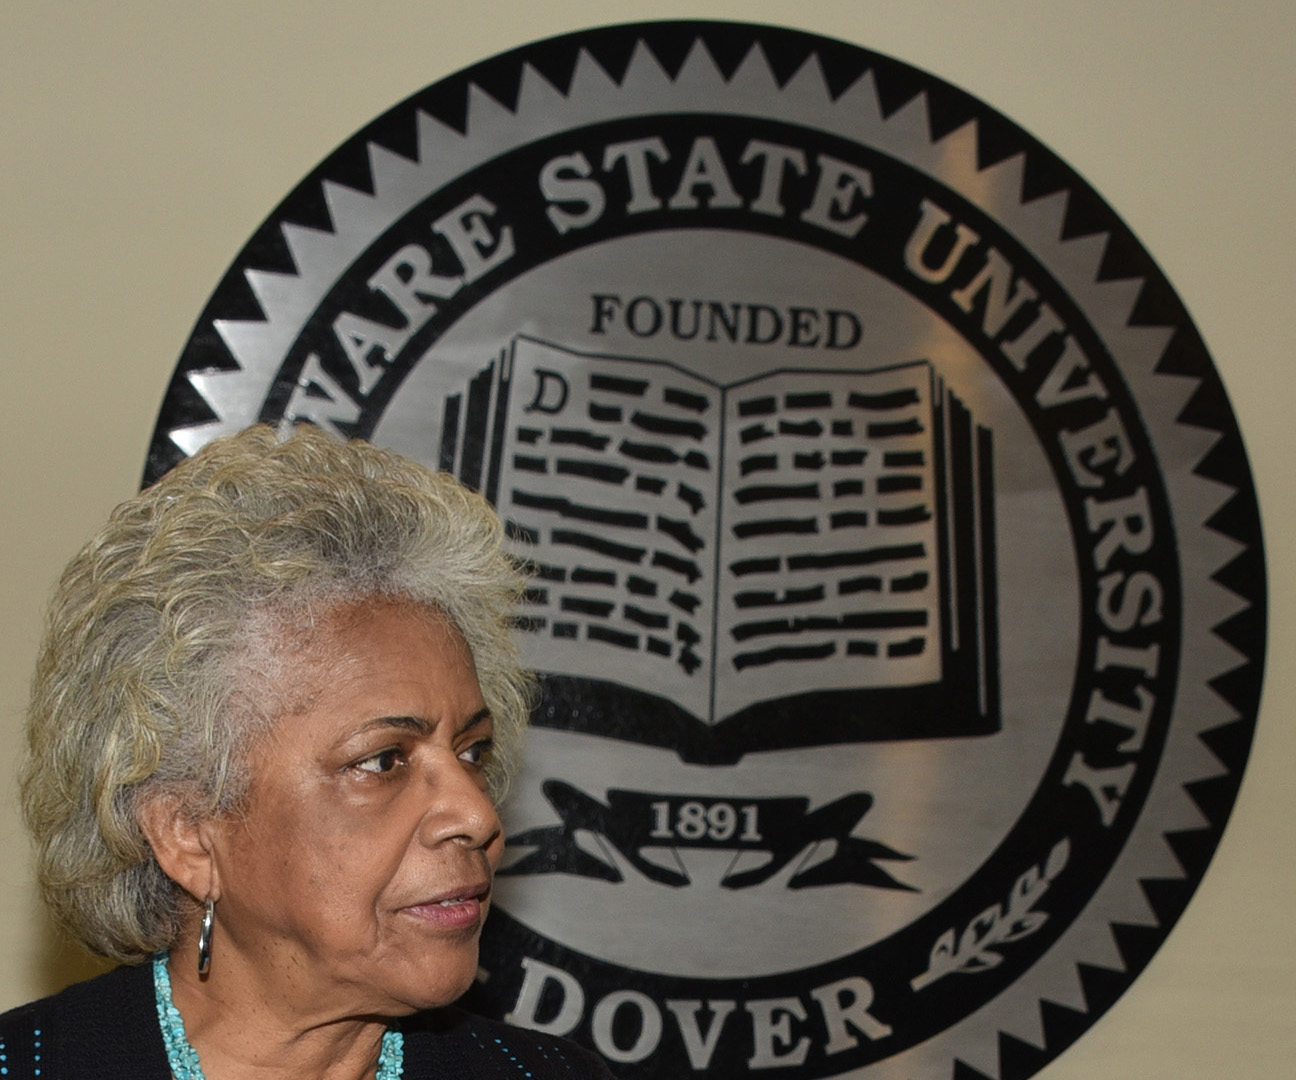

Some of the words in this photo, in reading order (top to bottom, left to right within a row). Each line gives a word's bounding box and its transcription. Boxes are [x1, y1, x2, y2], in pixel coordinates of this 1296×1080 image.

[591, 294, 863, 350] FOUNDED
[539, 136, 874, 238] STATE
[904, 199, 1163, 827] UNIVERSITY
[649, 801, 763, 842] 1891
[505, 956, 894, 1070] DOVER
